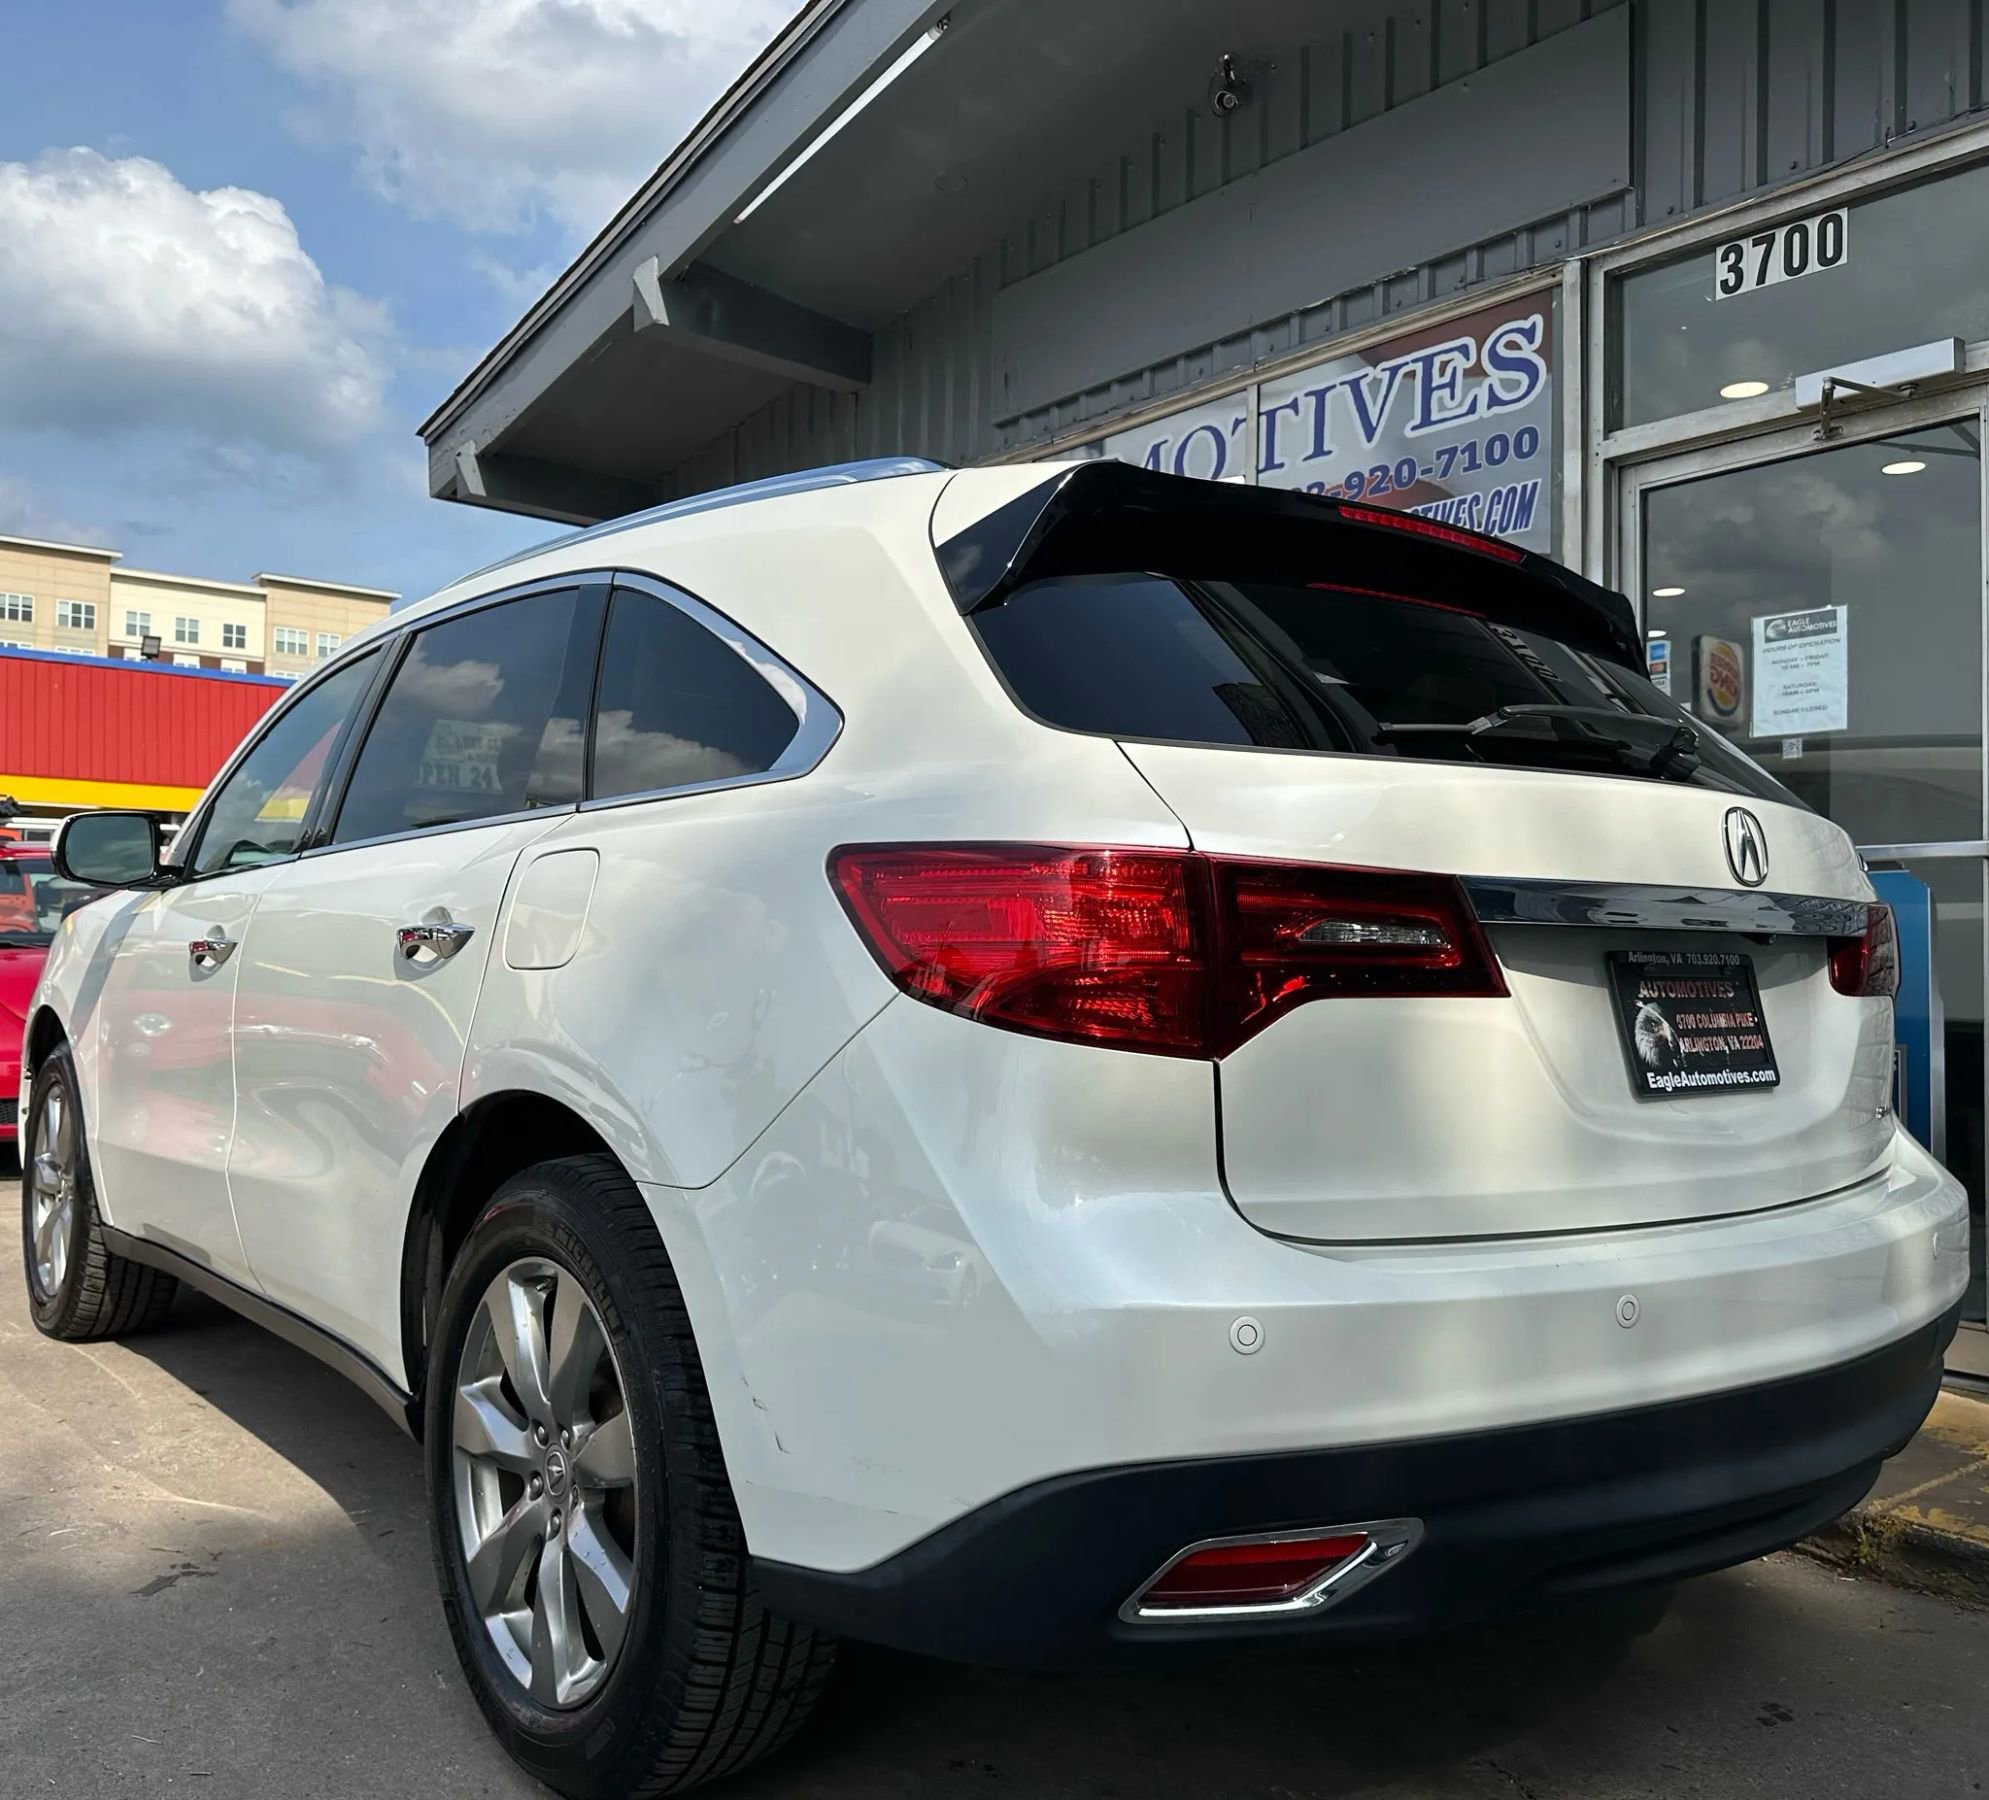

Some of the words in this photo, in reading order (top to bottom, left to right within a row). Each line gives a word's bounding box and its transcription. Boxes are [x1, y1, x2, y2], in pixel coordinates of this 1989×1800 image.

[1720, 213, 1843, 295] 3700
[1290, 426, 1540, 501] -920-7100
[1409, 479, 1542, 536] ES.COM
[1787, 617, 1810, 626] EAGLE
[1787, 620, 1837, 634] AUTOMOTIVES
[1628, 951, 1670, 966] Arlington,
[1670, 953, 1683, 965] VA
[1686, 953, 1740, 966] 703.920.7100
[1638, 980, 1735, 998] AUTOMOTIVES
[1697, 1012, 1736, 1029] COLUMBIA
[1736, 1012, 1755, 1027] PIKE
[1679, 1035, 1730, 1054] ARLINGTON,
[1729, 1035, 1741, 1050] VA
[1646, 1068, 1777, 1092] EagleAutomotives.com
